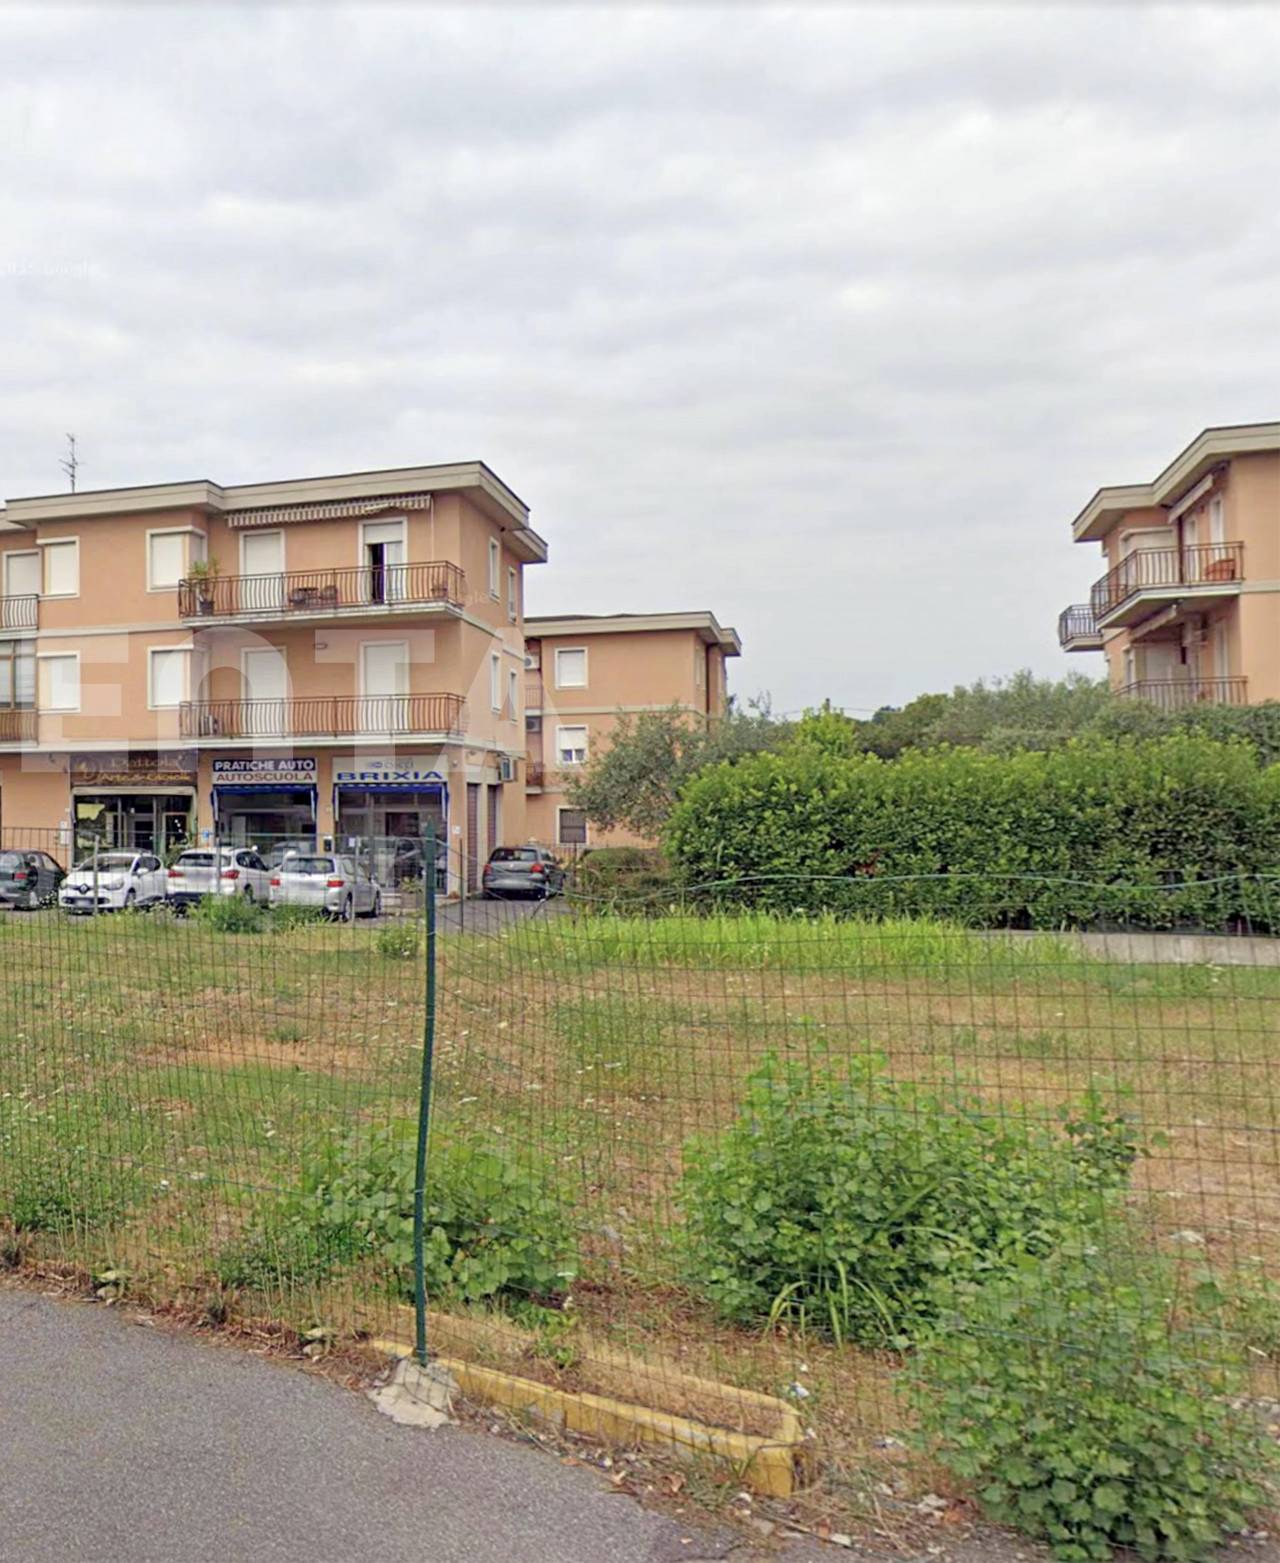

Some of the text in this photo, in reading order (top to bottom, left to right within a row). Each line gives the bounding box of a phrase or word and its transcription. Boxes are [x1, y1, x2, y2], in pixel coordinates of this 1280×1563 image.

[215, 759, 314, 771] PRATICHE AUTO
[216, 772, 313, 782] AUTOSCUOLA
[336, 771, 443, 781] BRIXIA
